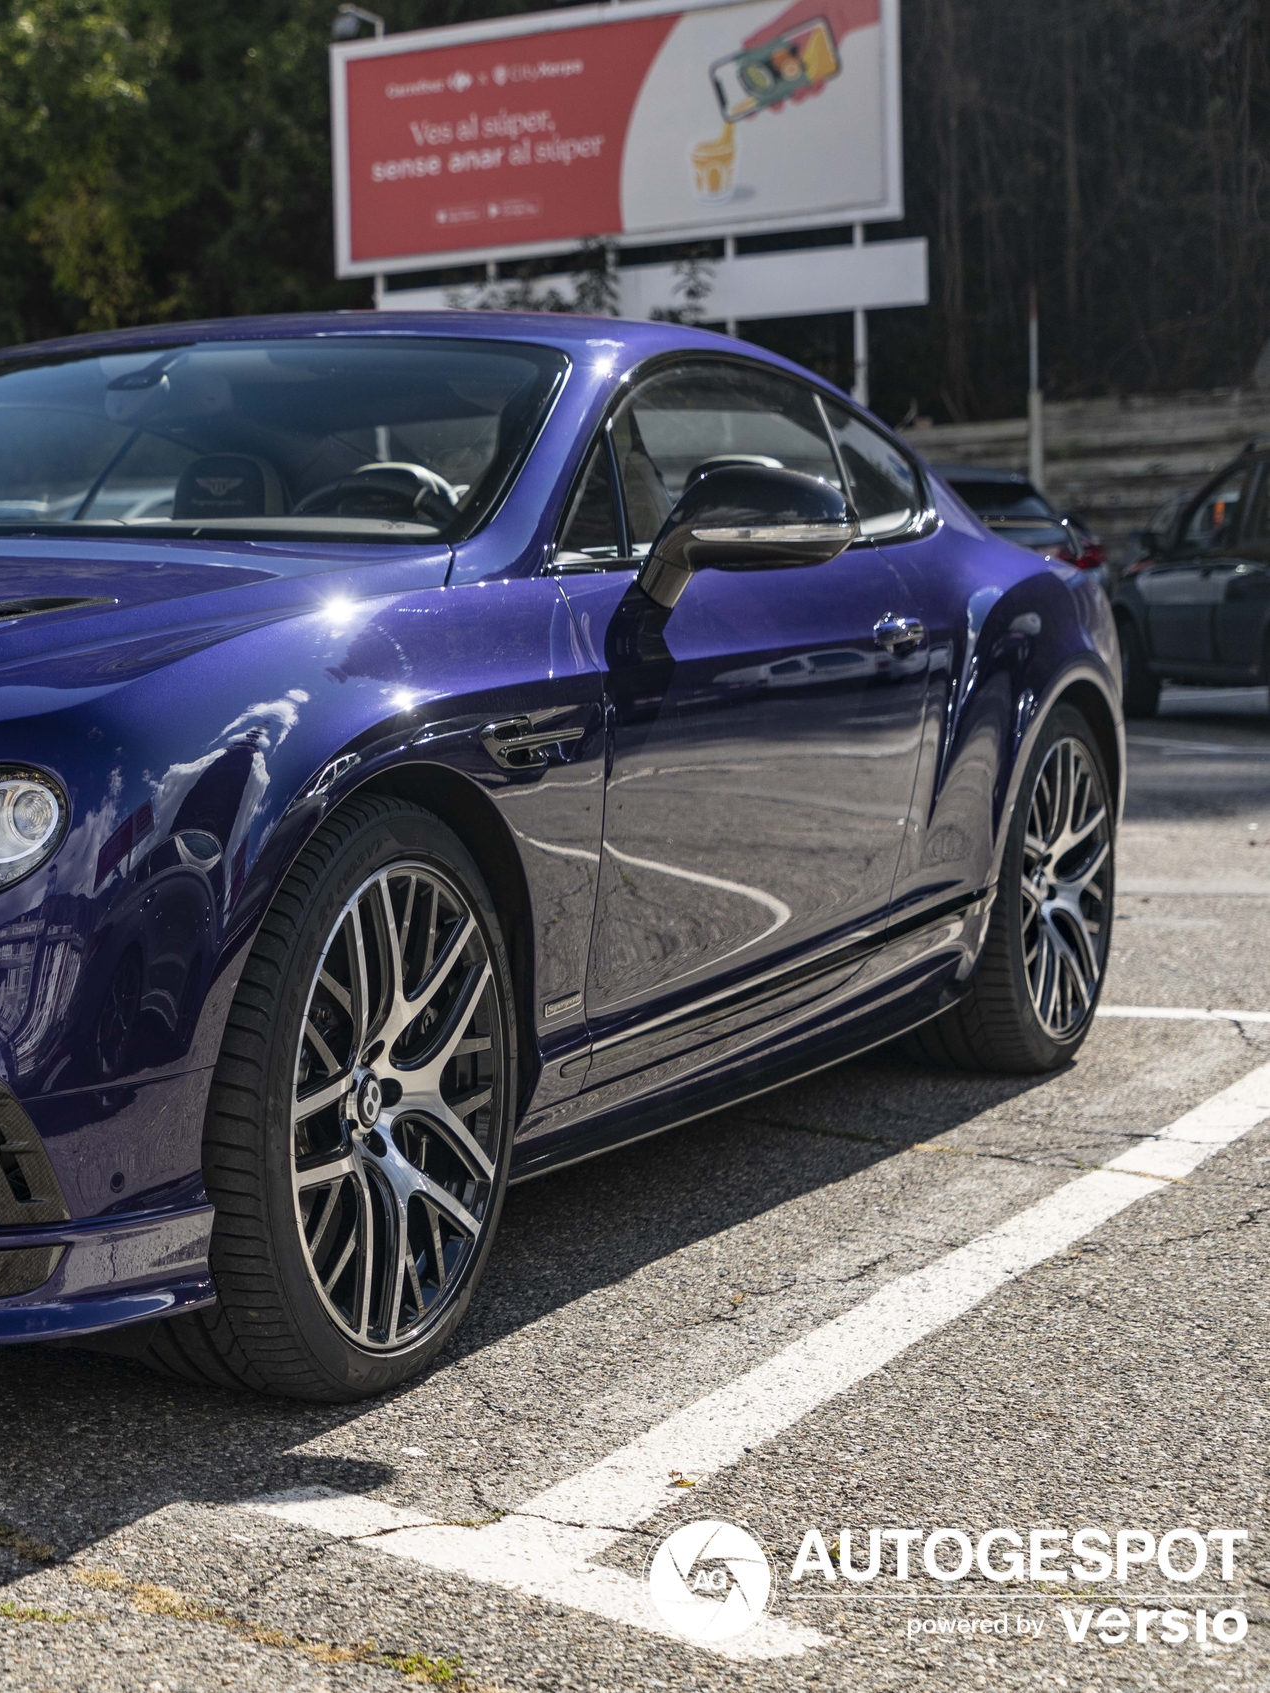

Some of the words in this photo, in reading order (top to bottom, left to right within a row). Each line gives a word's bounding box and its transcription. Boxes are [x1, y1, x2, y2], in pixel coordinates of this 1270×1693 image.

[410, 120, 453, 145] Ves
[456, 113, 478, 141] al
[372, 155, 441, 181] sense
[448, 147, 503, 172] anar
[508, 137, 530, 166] al
[534, 133, 605, 165] súper
